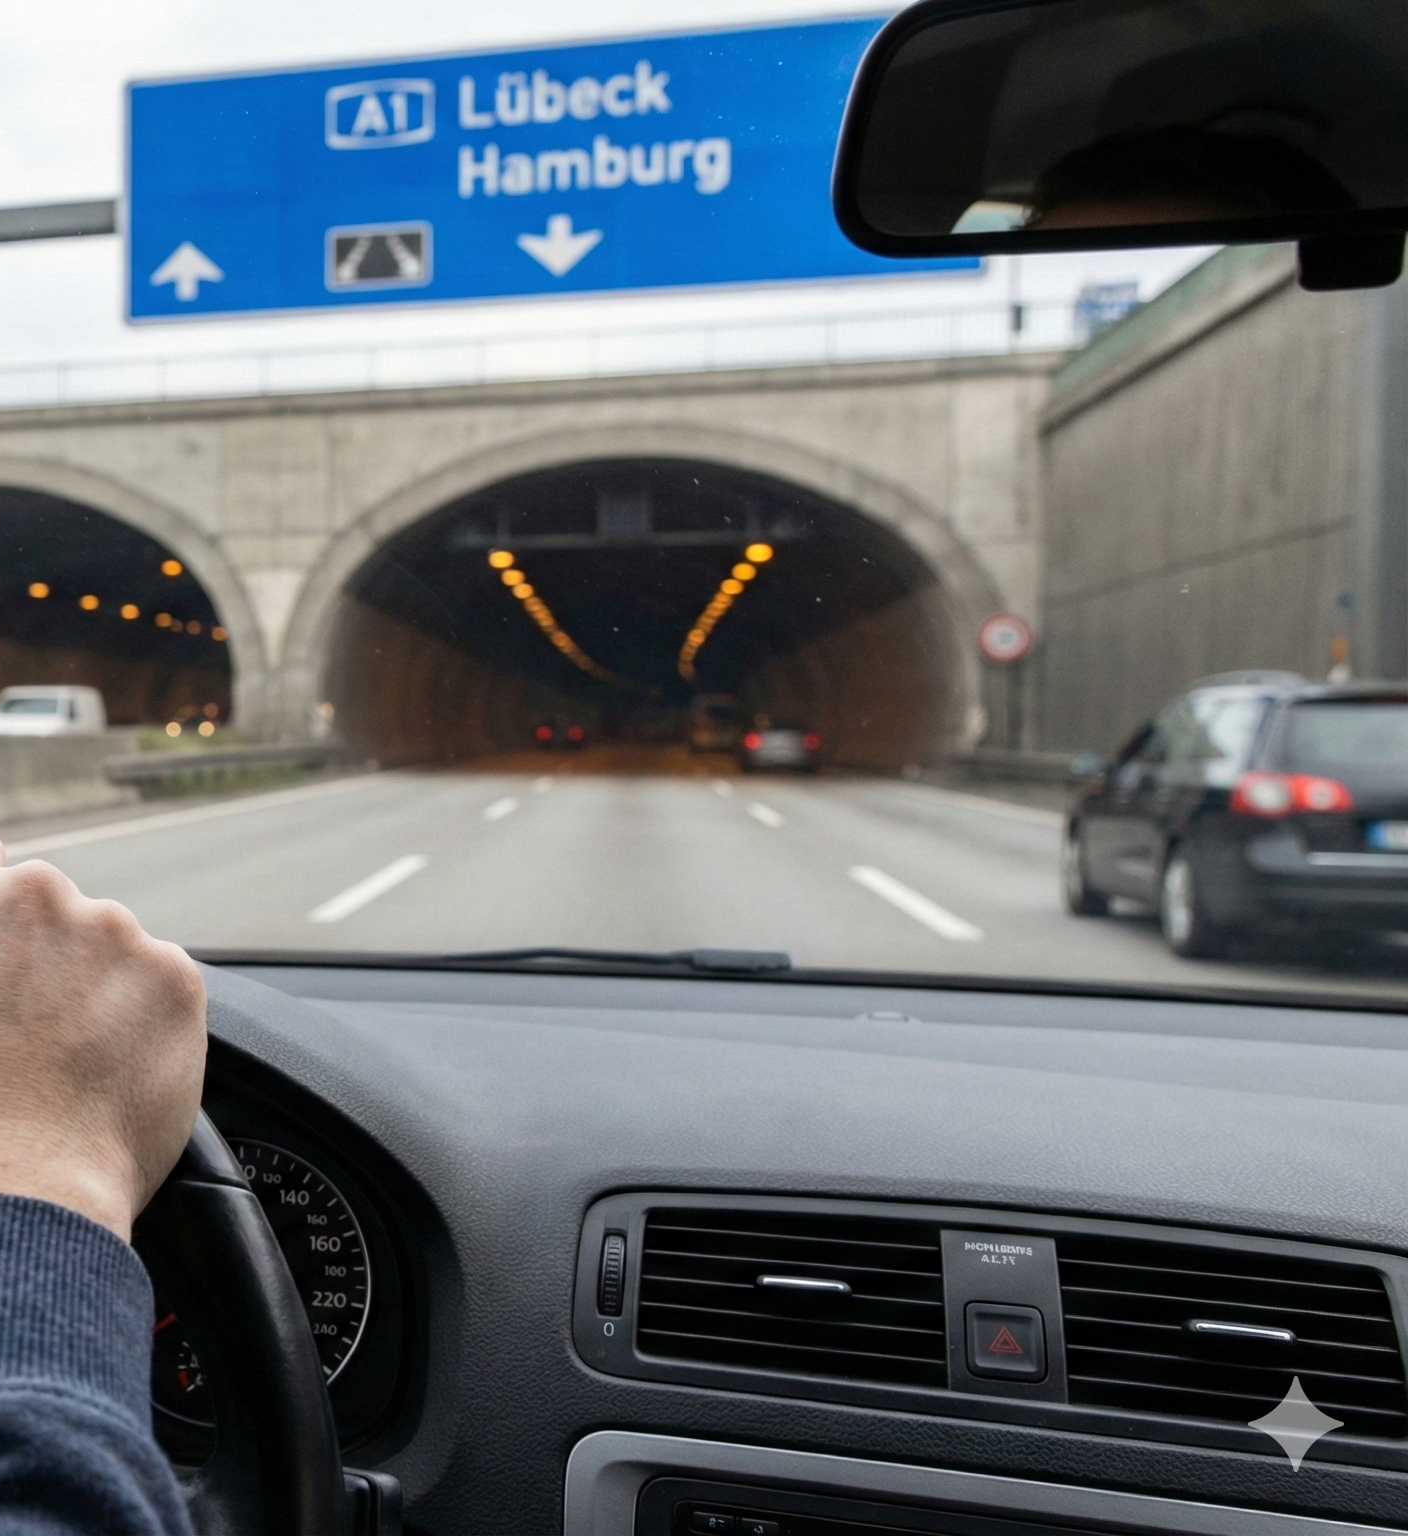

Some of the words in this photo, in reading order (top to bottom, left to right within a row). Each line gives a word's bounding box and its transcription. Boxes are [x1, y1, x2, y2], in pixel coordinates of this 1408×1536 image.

[458, 59, 669, 130] Lübeck
[353, 94, 408, 137] A1
[458, 135, 732, 198] Hamburg
[279, 1189, 310, 1206] 140
[309, 1235, 341, 1252] 160
[311, 1291, 346, 1308] 220
[603, 1321, 615, 1337] 0
